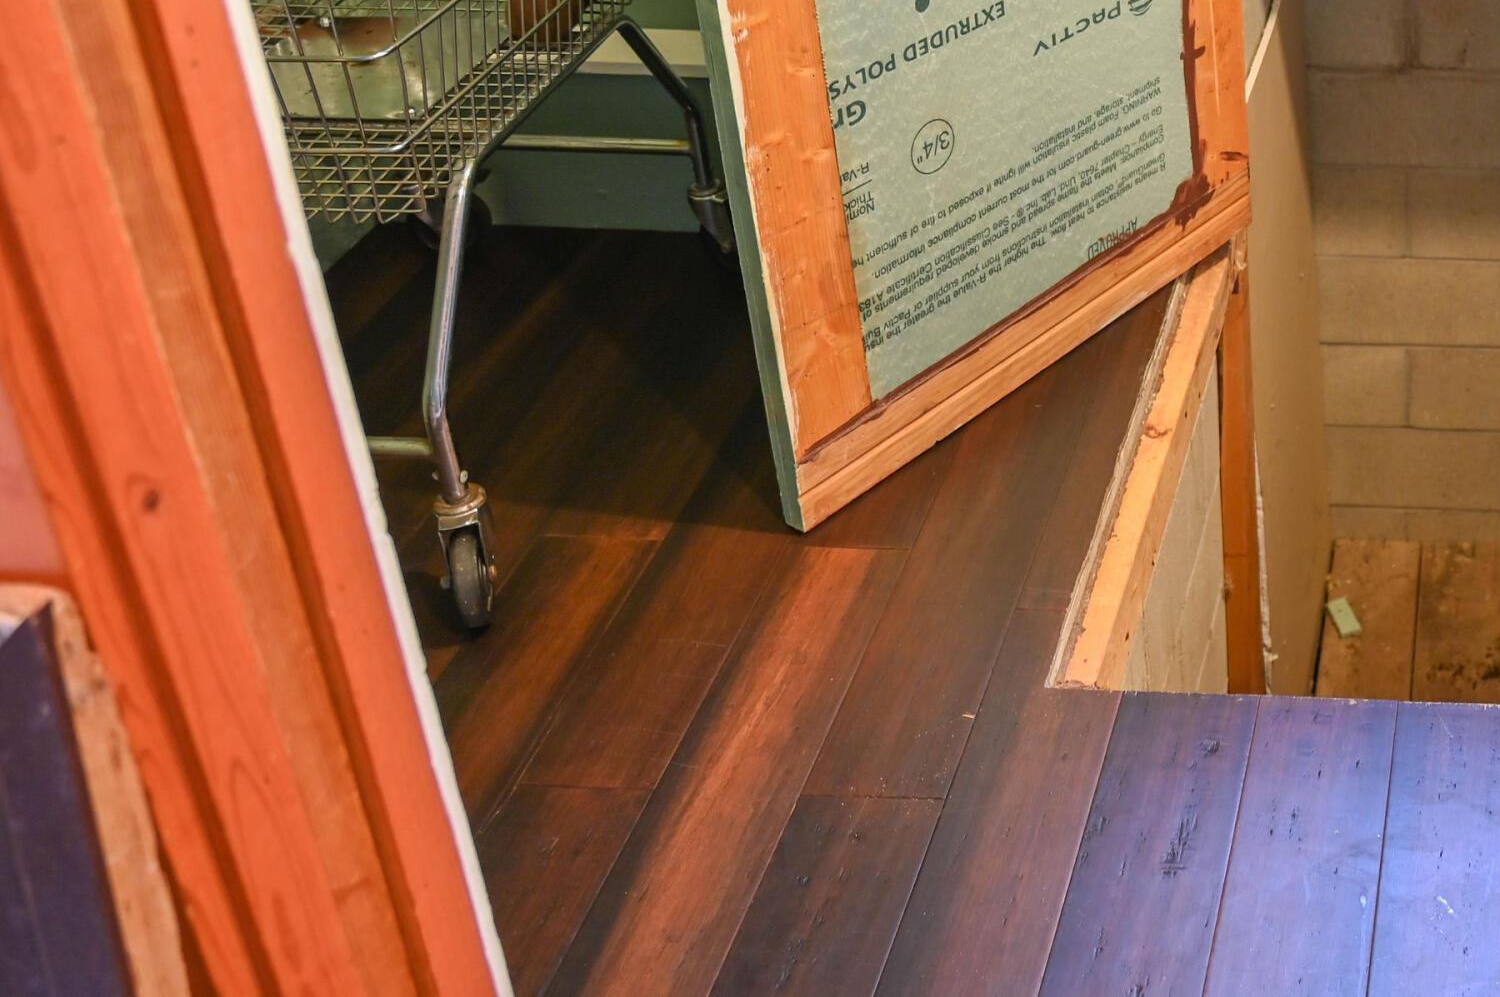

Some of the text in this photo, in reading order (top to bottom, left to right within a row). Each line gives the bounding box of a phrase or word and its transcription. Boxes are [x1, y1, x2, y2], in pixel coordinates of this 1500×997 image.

[1032, 0, 1120, 57] PACTIV
[828, 0, 1006, 101] EXTRUDED POLYS
[832, 100, 866, 130] Gr
[1077, 114, 1092, 129] and
[1098, 111, 1119, 126] Foam
[1032, 124, 1076, 152] installation.
[1072, 122, 1096, 144] plastic
[1138, 124, 1163, 143] Energy
[1032, 138, 1070, 165] insulation
[1101, 144, 1130, 166] Chapter
[1018, 161, 1030, 178] will
[1094, 162, 1116, 180] Meets
[1160, 162, 1166, 171] R
[993, 169, 1016, 186] ignite
[1080, 177, 1092, 188] the
[1135, 168, 1158, 185] means
[871, 105, 1162, 279] Go to www.green-guard.com for the most current compliance information.
[986, 183, 991, 194] if
[1057, 186, 1078, 202] flame
[1091, 184, 1114, 202] obtain
[1096, 182, 1132, 209] resistance
[948, 186, 984, 214] exposed
[937, 209, 946, 219] to
[1028, 198, 1055, 222] spread
[1049, 199, 1089, 228] installation
[1087, 207, 1094, 215] to
[921, 216, 936, 229] fire
[993, 216, 1009, 231] See
[1010, 216, 1026, 232] and
[1068, 214, 1085, 227] heat
[910, 225, 918, 238] of
[982, 227, 1009, 248] smoke
[1002, 225, 1047, 256] instructions
[866, 231, 907, 262] sufficient
[934, 227, 990, 266] Classification
[1031, 236, 1046, 250] The
[936, 244, 980, 276] developed
[982, 254, 1000, 270] from
[1003, 247, 1028, 268] higher
[886, 262, 932, 294] Certificate
[960, 264, 979, 282] your
[989, 264, 1002, 275] the
[874, 272, 934, 313] requirements
[924, 278, 958, 305] supplier
[953, 272, 986, 298] R-Value
[914, 301, 922, 312] or
[937, 294, 951, 308] the
[862, 310, 872, 322] of
[883, 308, 910, 329] Pactiv
[902, 303, 935, 330] greater
[886, 326, 901, 339] the
